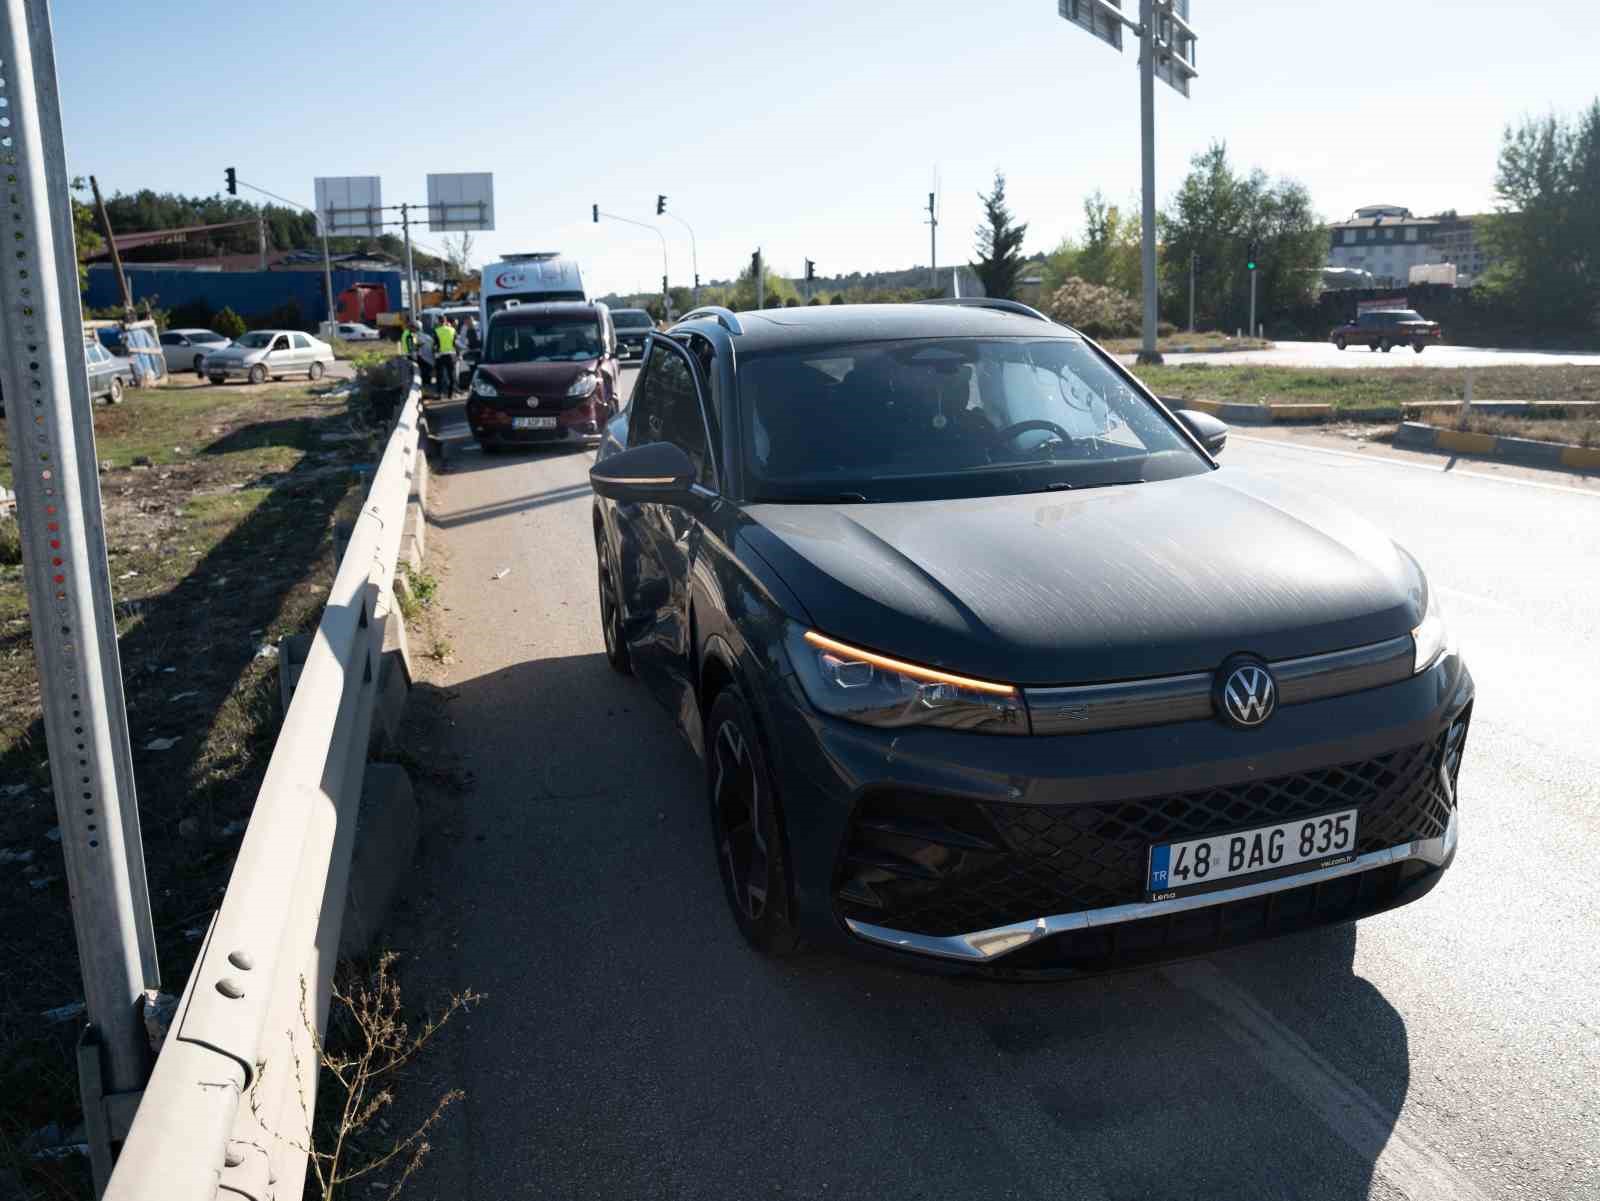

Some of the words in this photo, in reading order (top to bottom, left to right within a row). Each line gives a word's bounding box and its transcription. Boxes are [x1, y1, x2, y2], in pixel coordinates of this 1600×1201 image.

[1225, 666, 1274, 724] VW
[1152, 870, 1167, 881] TR
[1173, 843, 1211, 880] 48
[1228, 829, 1285, 872] BAG
[1299, 814, 1351, 857] 835
